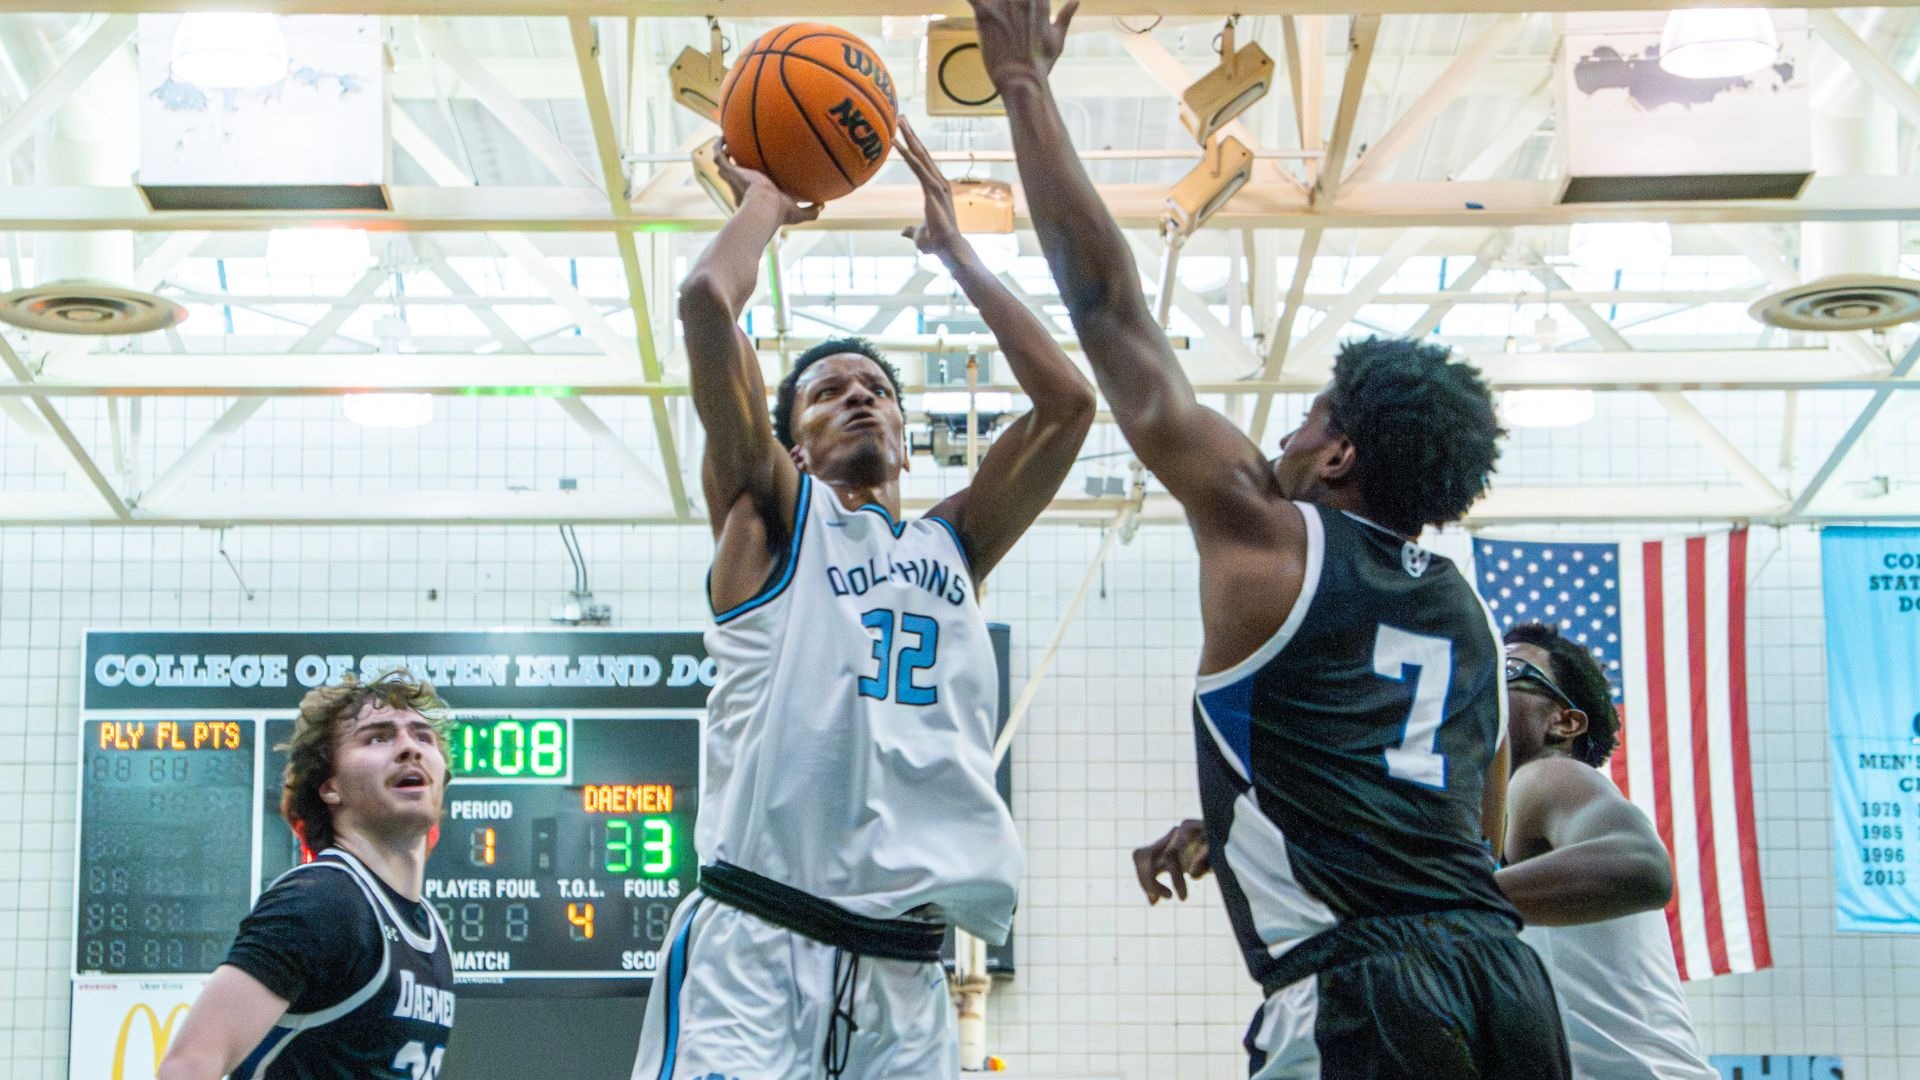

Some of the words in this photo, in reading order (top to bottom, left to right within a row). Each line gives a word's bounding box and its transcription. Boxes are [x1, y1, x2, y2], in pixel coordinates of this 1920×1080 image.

[858, 608, 939, 706] 32
[95, 654, 288, 687] COLLEGE
[295, 654, 354, 687] OF
[360, 654, 510, 687] STATEN
[515, 655, 662, 687] ISLAND
[1373, 622, 1455, 791] 7
[100, 721, 144, 750] PLY
[156, 721, 187, 750] FL
[193, 721, 241, 750] PTS
[464, 721, 563, 776] 1:08
[584, 784, 673, 813] DAEMEN
[451, 800, 513, 819] PERIOD
[1862, 801, 1901, 818] 1979
[1862, 824, 1903, 840] 1985
[484, 828, 496, 865] 1
[1862, 847, 1905, 863] 1996
[1863, 870, 1906, 886] 2013
[425, 879, 491, 898] PLAYER
[496, 879, 541, 898] FOUL
[558, 879, 604, 898] T.O.L.
[624, 879, 680, 898] FOULS
[567, 902, 595, 939] 4
[453, 951, 511, 970] MATCH
